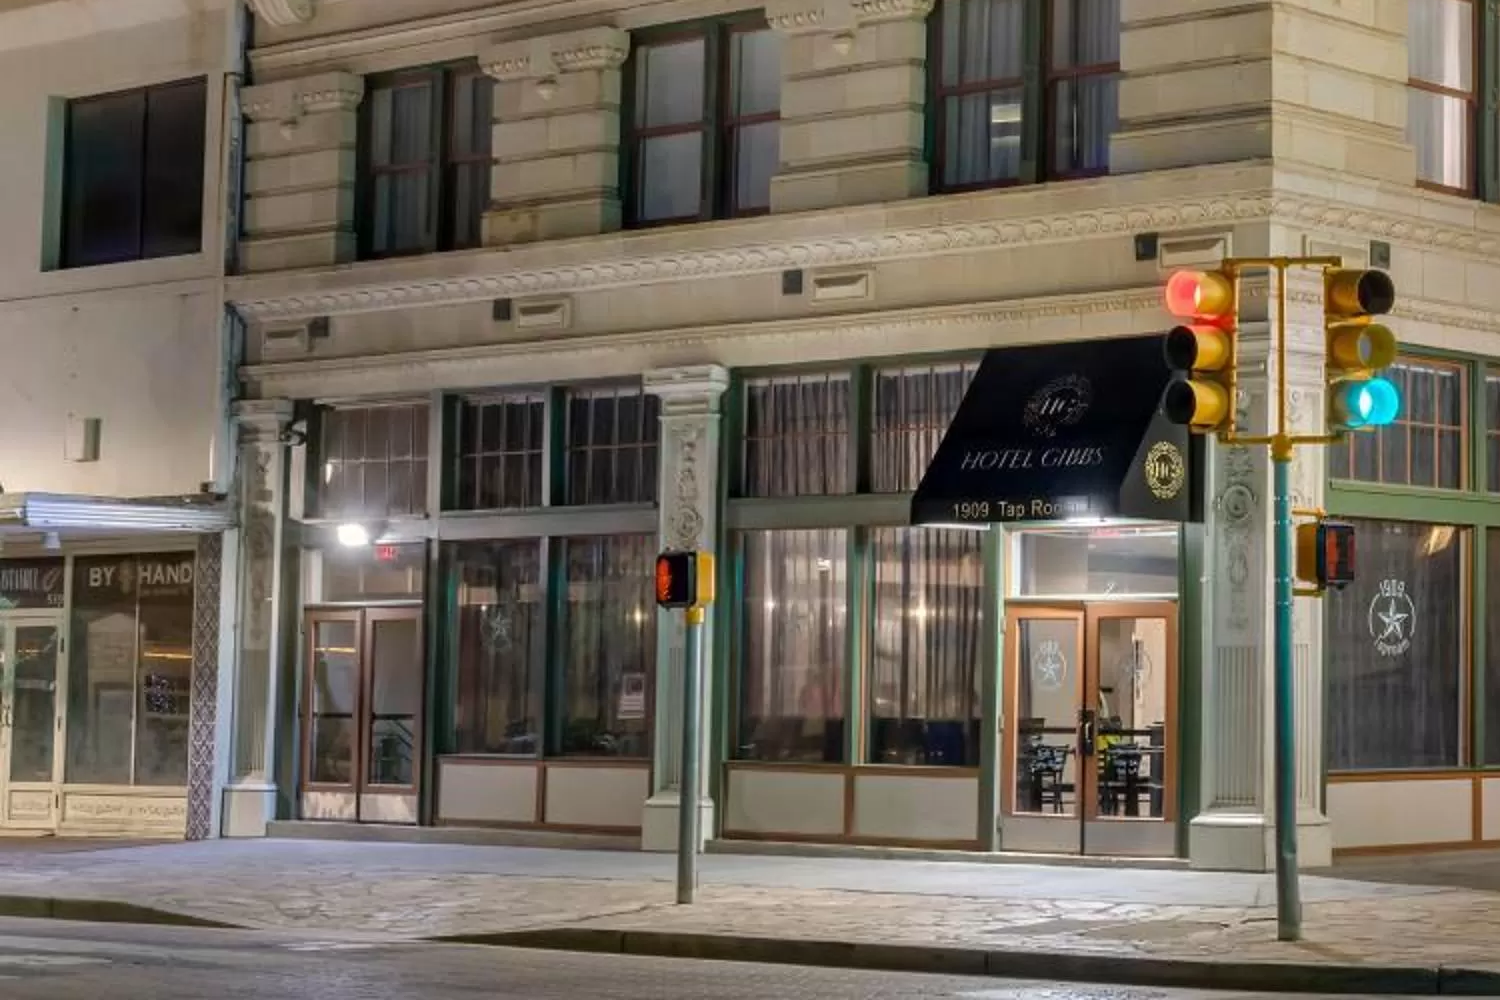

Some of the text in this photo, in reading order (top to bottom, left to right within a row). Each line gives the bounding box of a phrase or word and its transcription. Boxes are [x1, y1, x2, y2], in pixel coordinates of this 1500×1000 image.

[961, 447, 1103, 470] HOTEL GIBBS
[954, 502, 989, 519] 1909
[1000, 502, 1024, 518] Tap
[88, 563, 193, 587] BY HAND
